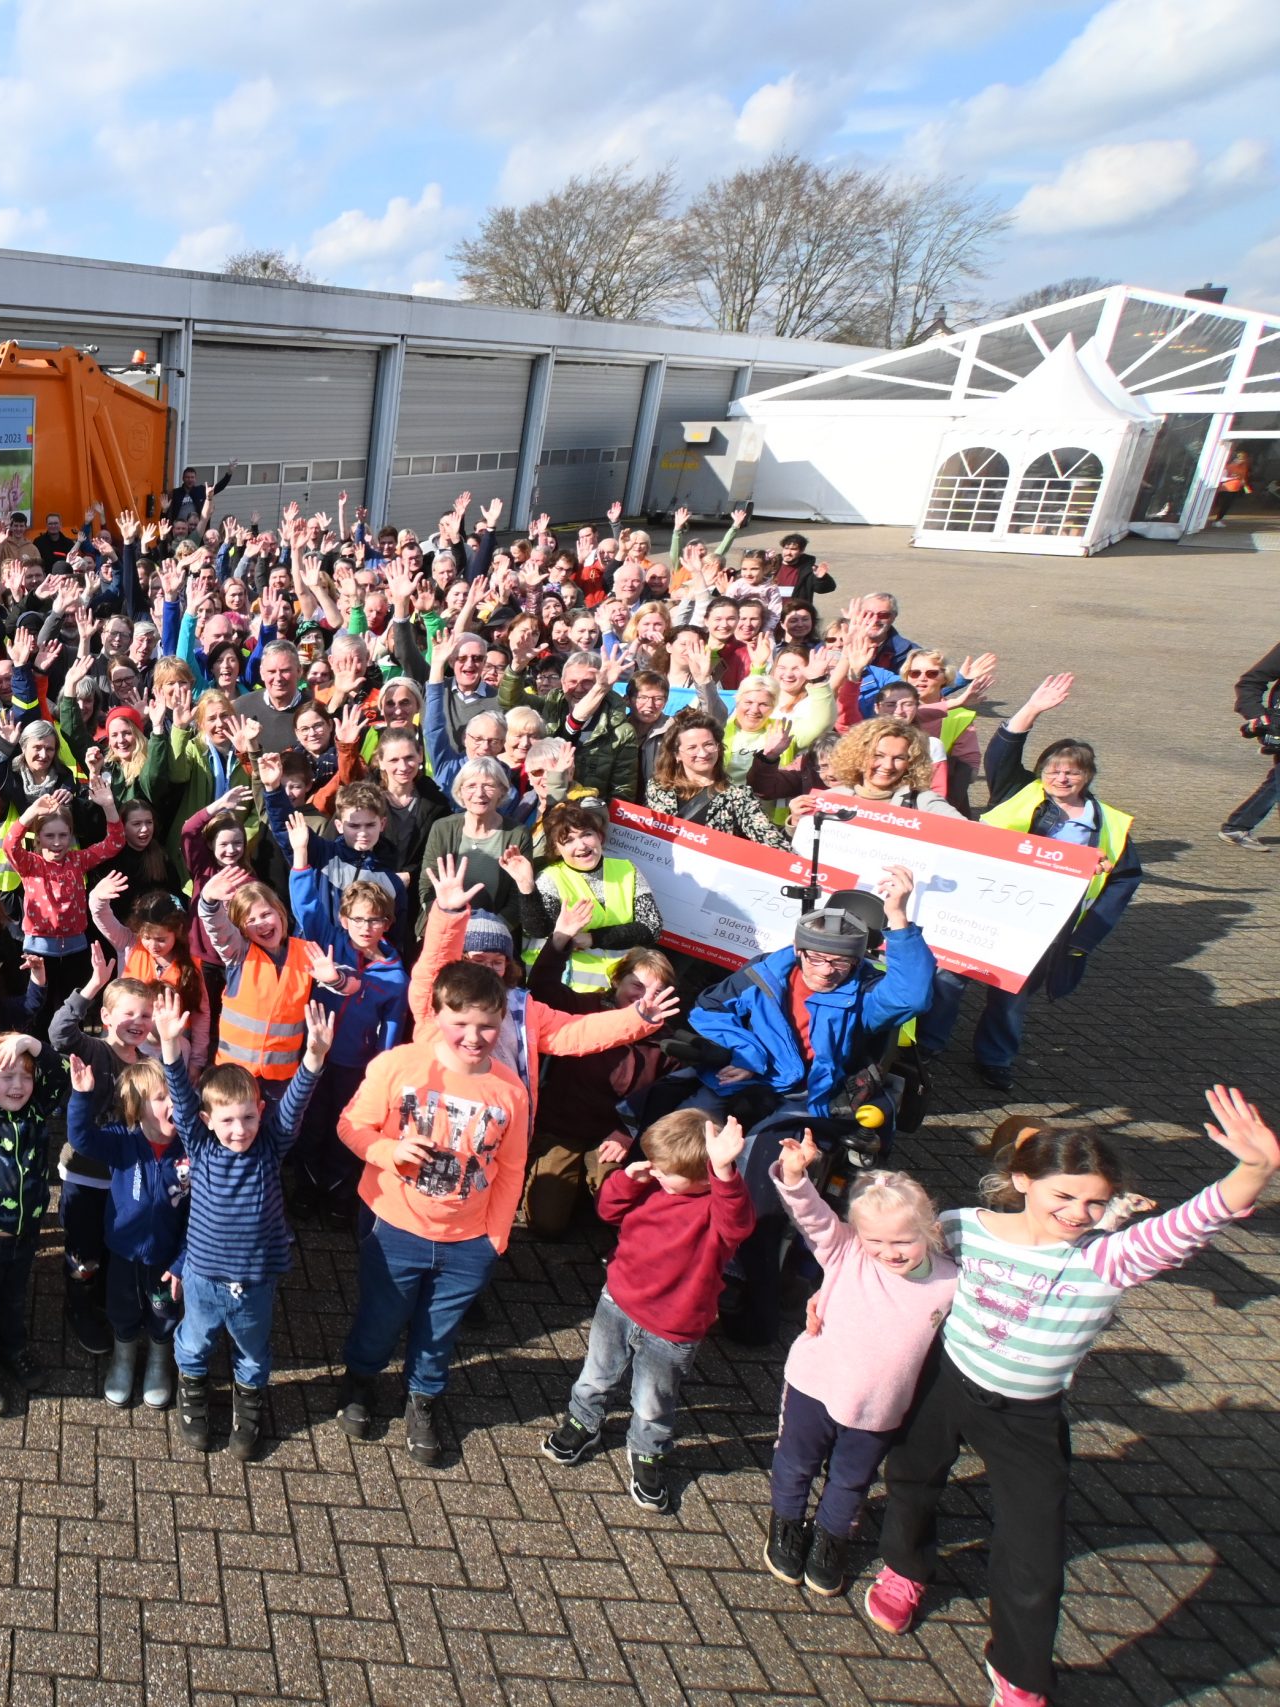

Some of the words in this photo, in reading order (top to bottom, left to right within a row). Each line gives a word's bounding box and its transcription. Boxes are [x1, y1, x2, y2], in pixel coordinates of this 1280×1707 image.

[4, 433, 21, 444] 2023
[616, 807, 710, 845] Spendenscheck
[612, 827, 662, 849] KulturTafel
[609, 838, 656, 861] Oldenburg
[869, 849, 926, 871] Oldenburg
[1035, 847, 1063, 861] LzO
[933, 924, 994, 950] 18.03.2023
